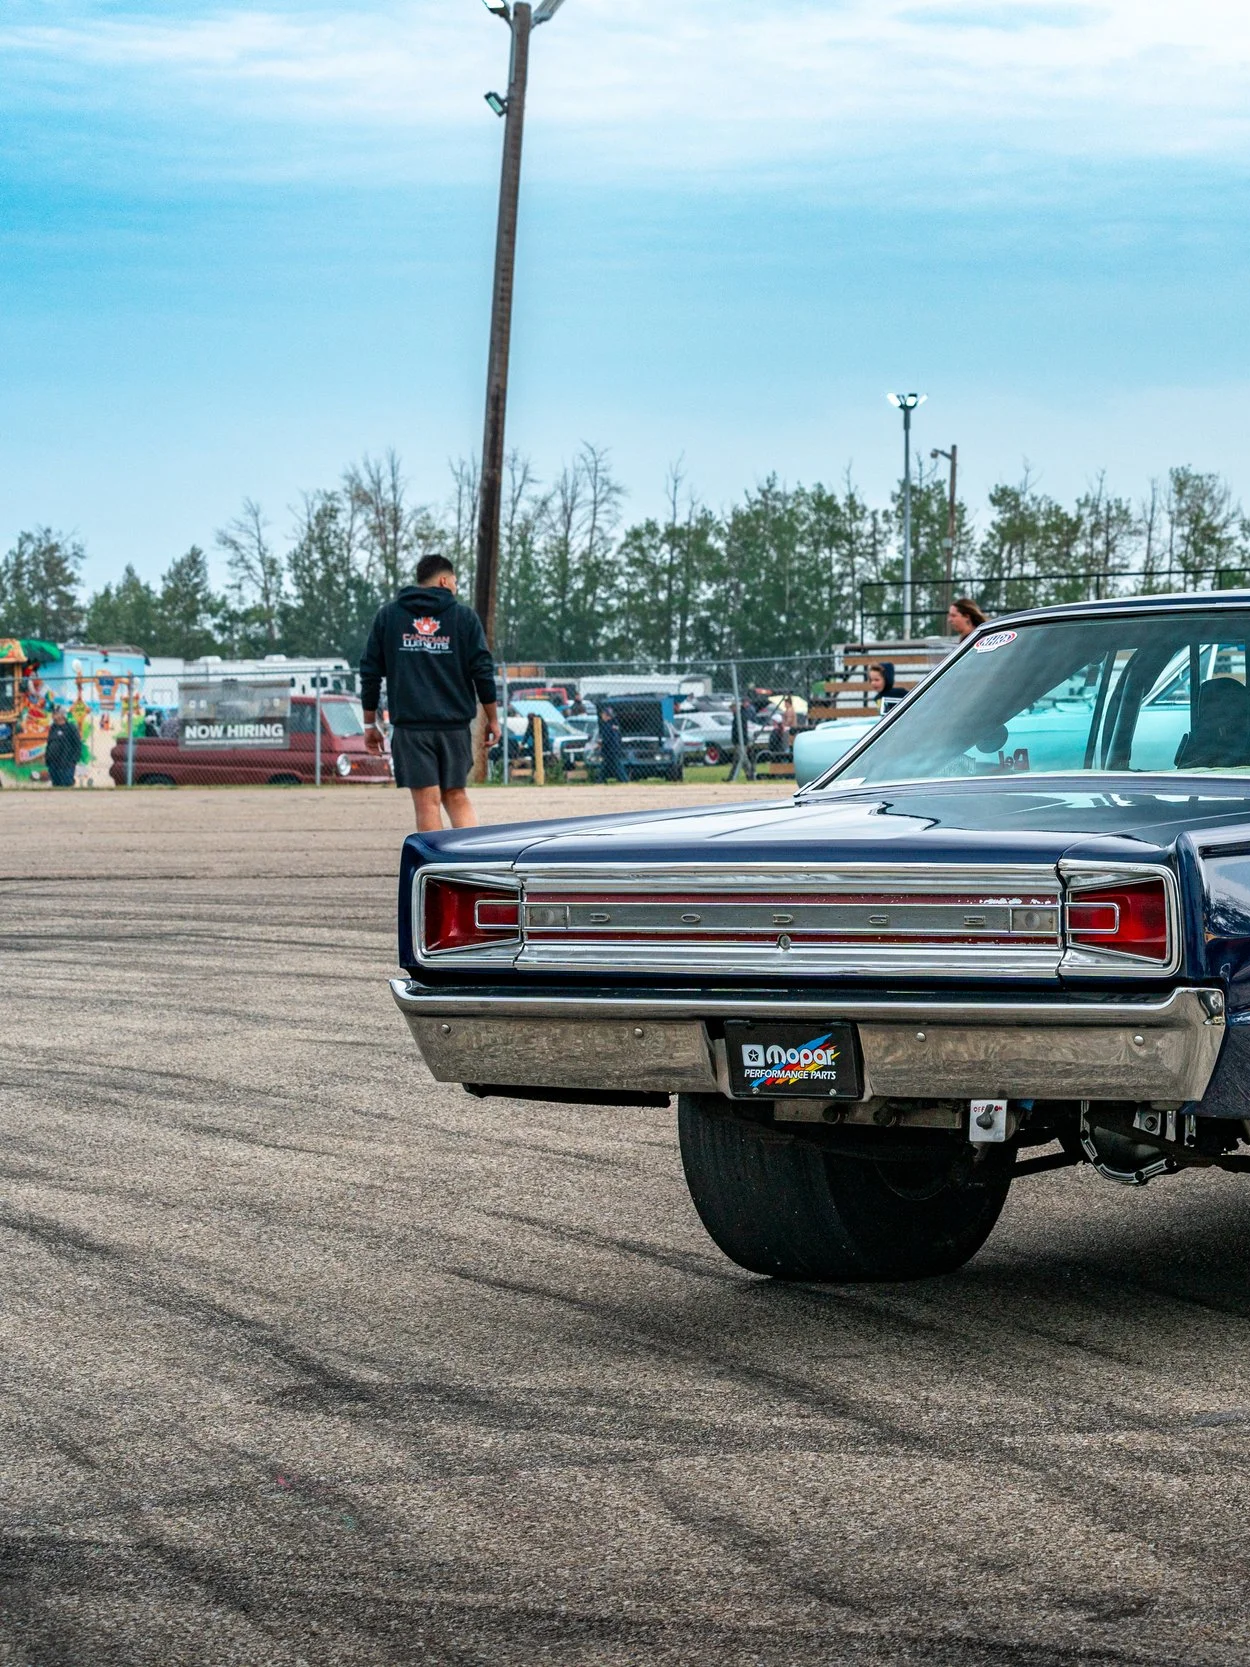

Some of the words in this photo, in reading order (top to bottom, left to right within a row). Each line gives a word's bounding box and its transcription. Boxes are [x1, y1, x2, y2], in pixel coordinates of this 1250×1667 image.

[403, 633, 450, 643] CANADIAN
[979, 633, 1013, 647] NHRA
[404, 639, 422, 647] LUG
[423, 640, 449, 650] NUTS
[185, 725, 224, 738] NOW
[227, 723, 284, 737] HIRING
[590, 912, 986, 925] DODGE
[744, 1069, 809, 1079] PERFORMANCE
[810, 1070, 836, 1080] PARTS
